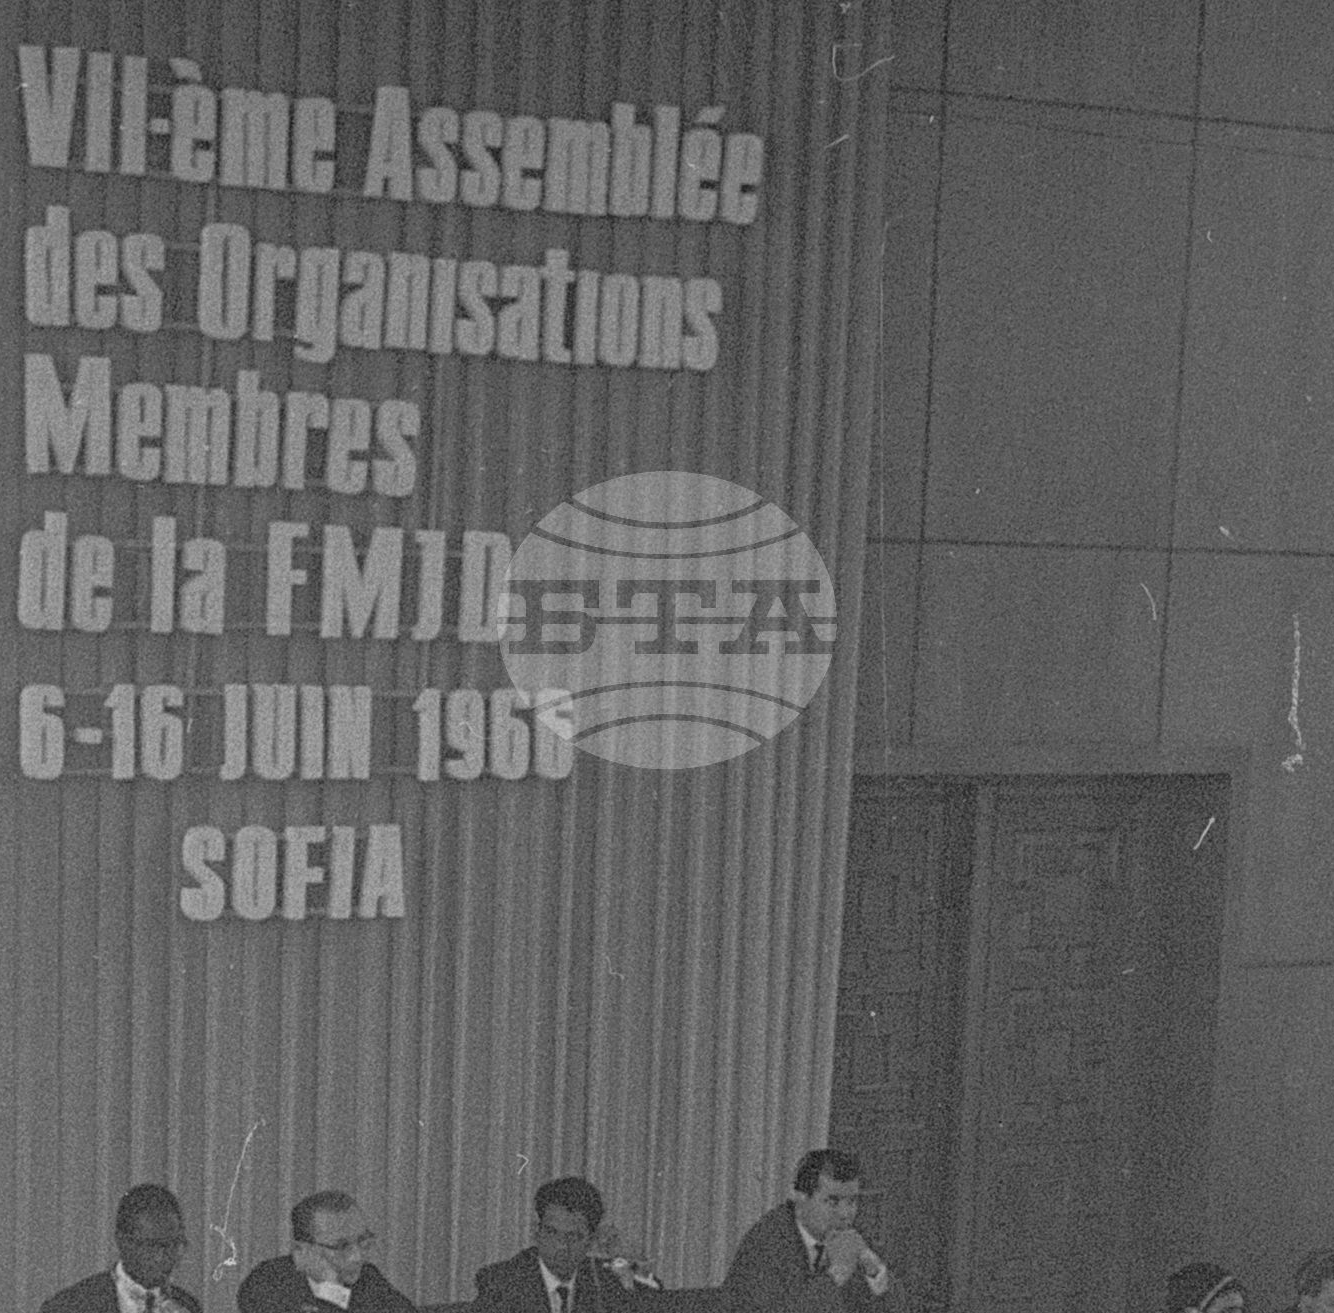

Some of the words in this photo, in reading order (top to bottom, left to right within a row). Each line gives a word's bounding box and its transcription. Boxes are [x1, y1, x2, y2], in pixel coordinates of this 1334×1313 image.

[18, 44, 335, 193] VII-ème
[363, 85, 764, 224] Assemblée
[25, 205, 165, 331] des
[198, 222, 723, 371] Organisations
[23, 353, 421, 497] Membres
[16, 510, 115, 633] de
[150, 515, 227, 635] la
[267, 521, 515, 642] FMJD
[18, 683, 187, 780] 6-16
[219, 683, 372, 781] JUIN
[413, 688, 575, 782] 1966
[179, 824, 405, 921] SOFIA
